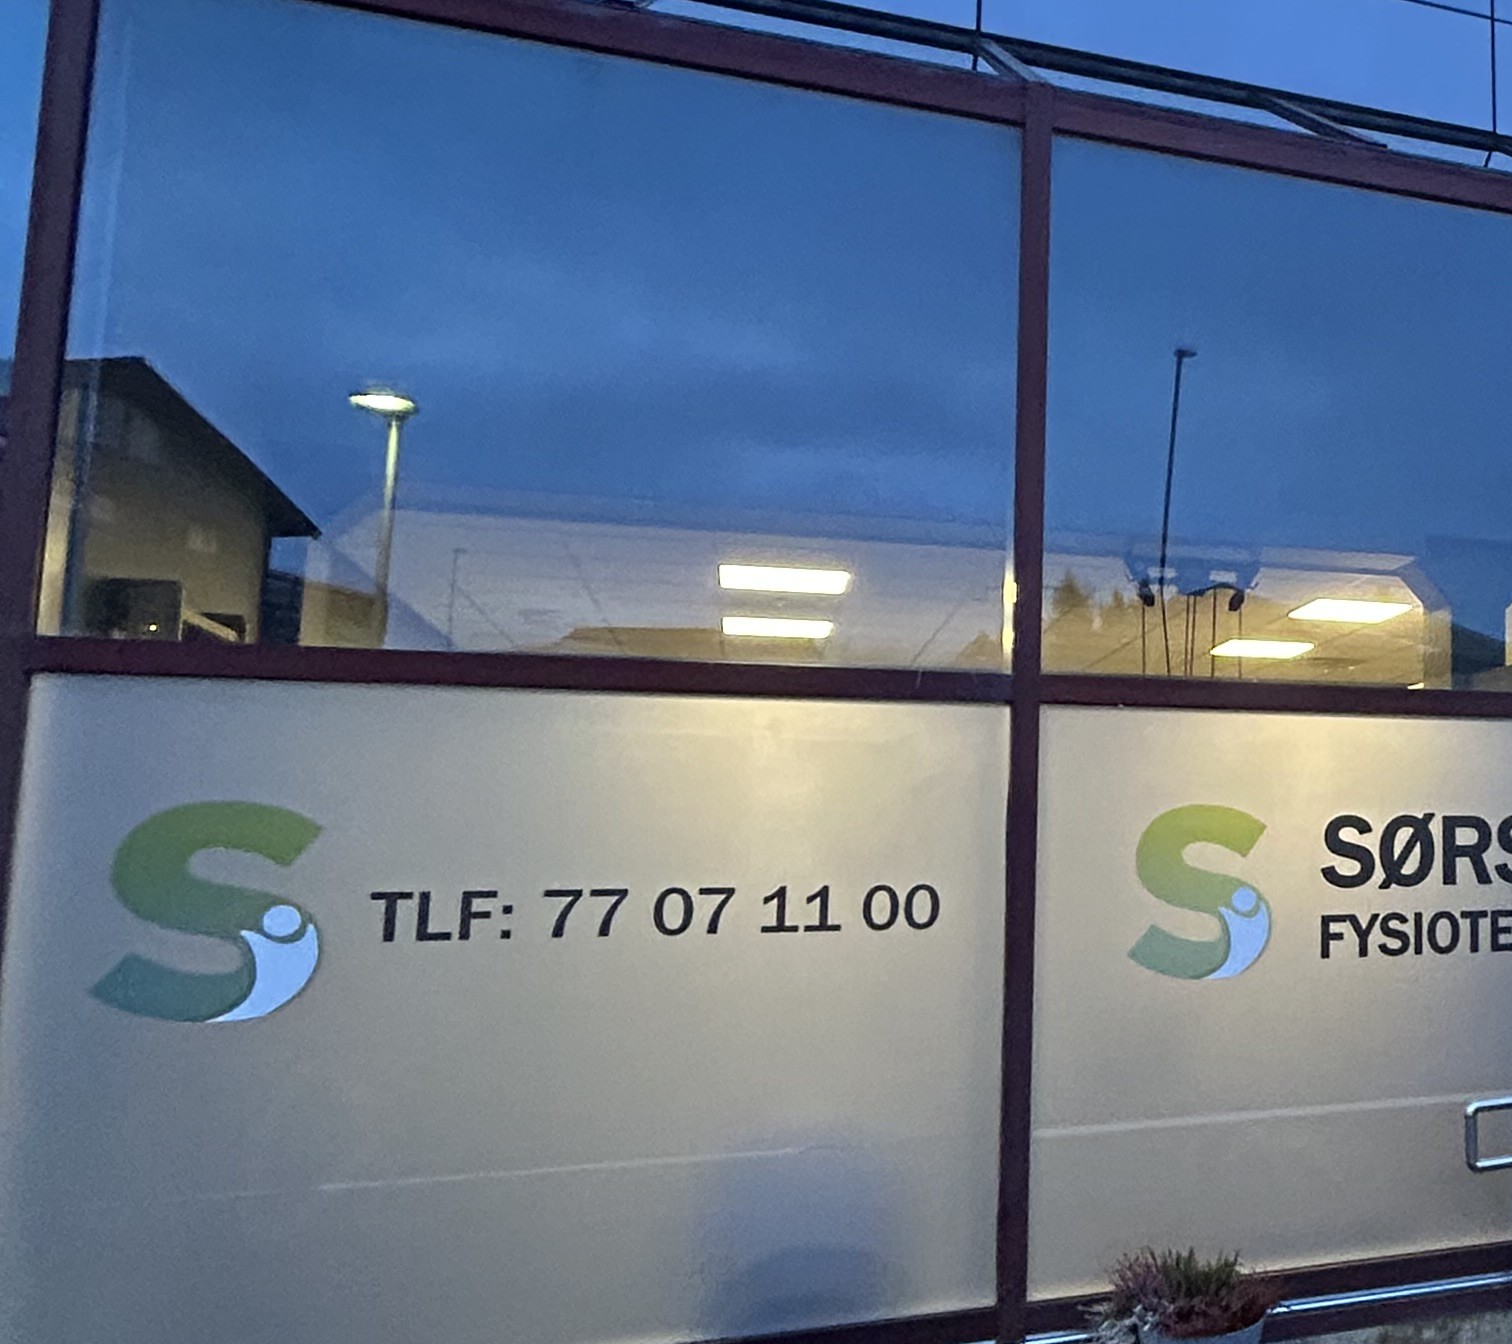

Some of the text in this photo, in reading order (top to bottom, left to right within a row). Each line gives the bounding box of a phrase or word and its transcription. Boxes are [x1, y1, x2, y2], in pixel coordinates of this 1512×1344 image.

[368, 883, 941, 943] TLF: 77 07 11 00
